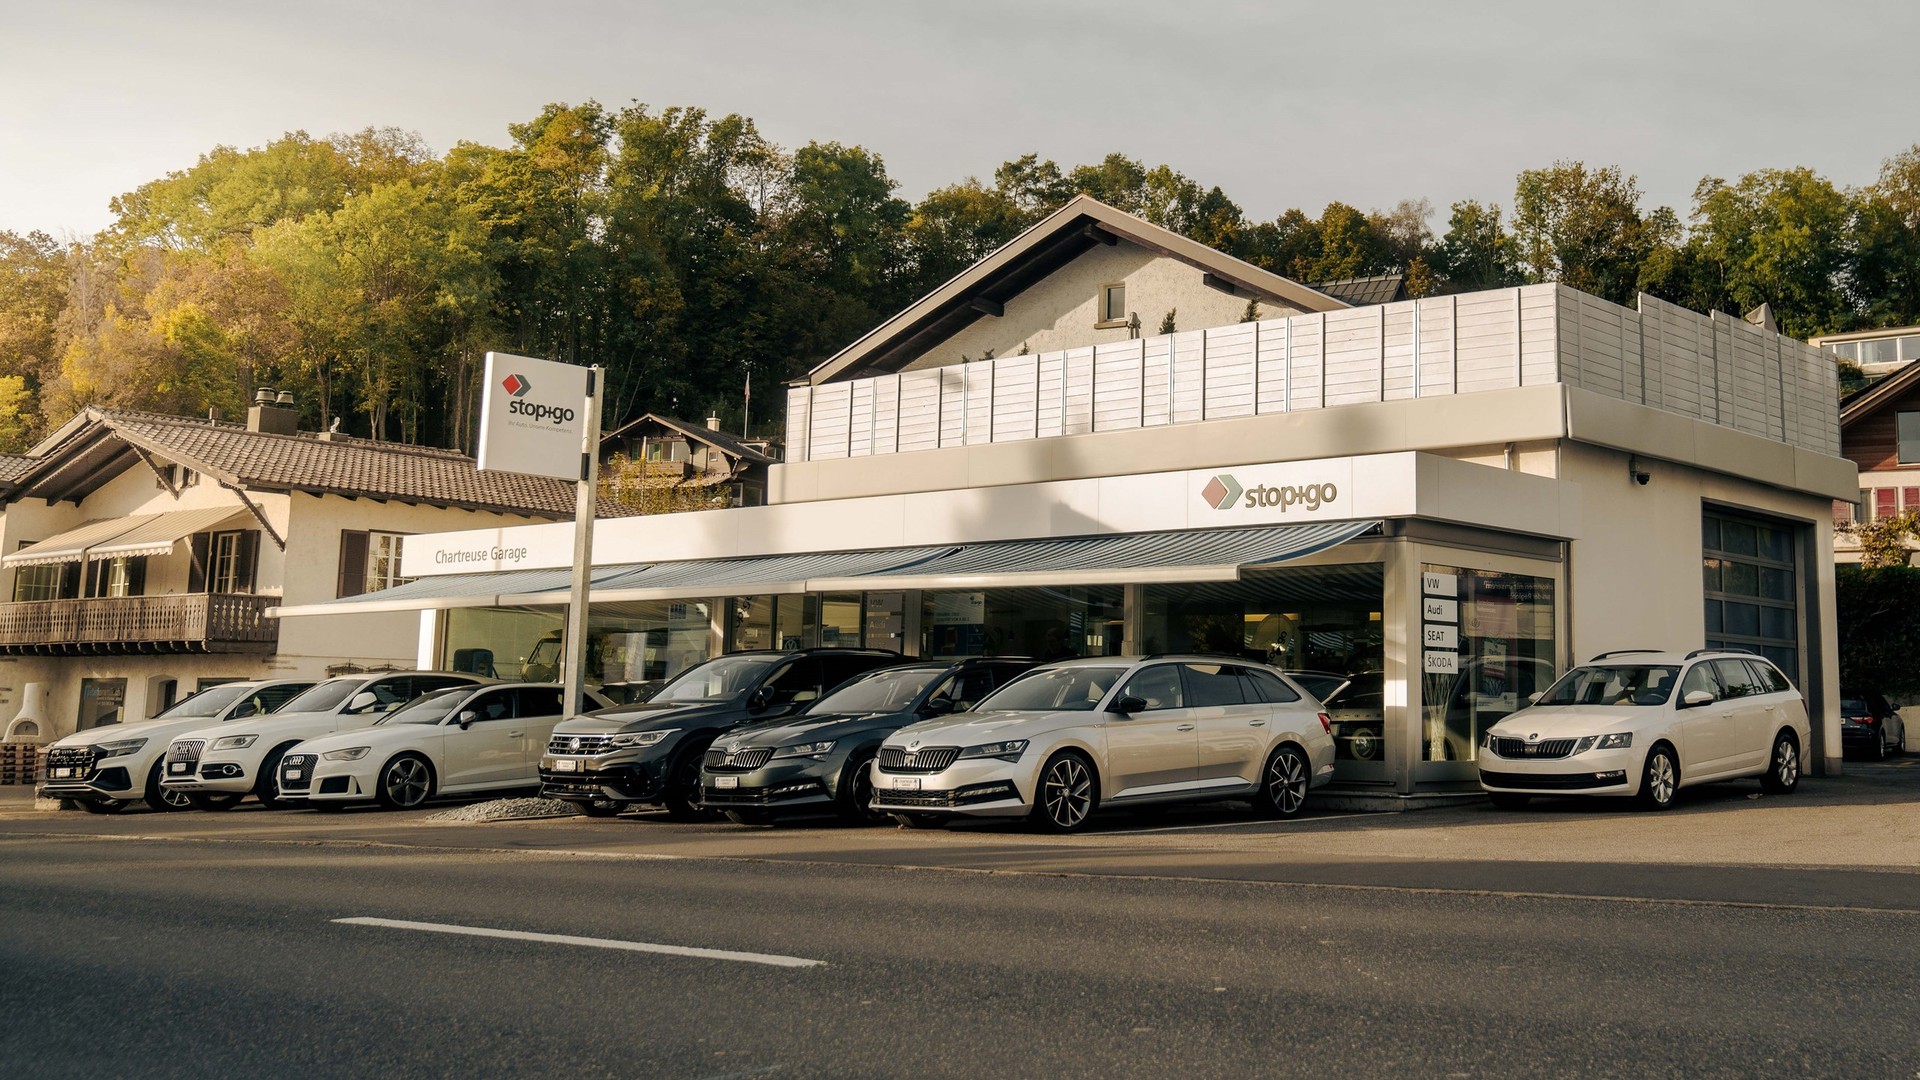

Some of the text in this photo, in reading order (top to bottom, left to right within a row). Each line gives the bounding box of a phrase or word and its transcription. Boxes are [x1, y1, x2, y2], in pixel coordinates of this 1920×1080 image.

[509, 399, 574, 424] stop+go
[1245, 483, 1337, 513] stop+go
[435, 546, 527, 564] Chartreuse Garage
[1427, 578, 1440, 589] VW
[1427, 604, 1443, 615] Audi
[1427, 630, 1444, 641] SEAT
[1428, 655, 1452, 668] ŠKODA
